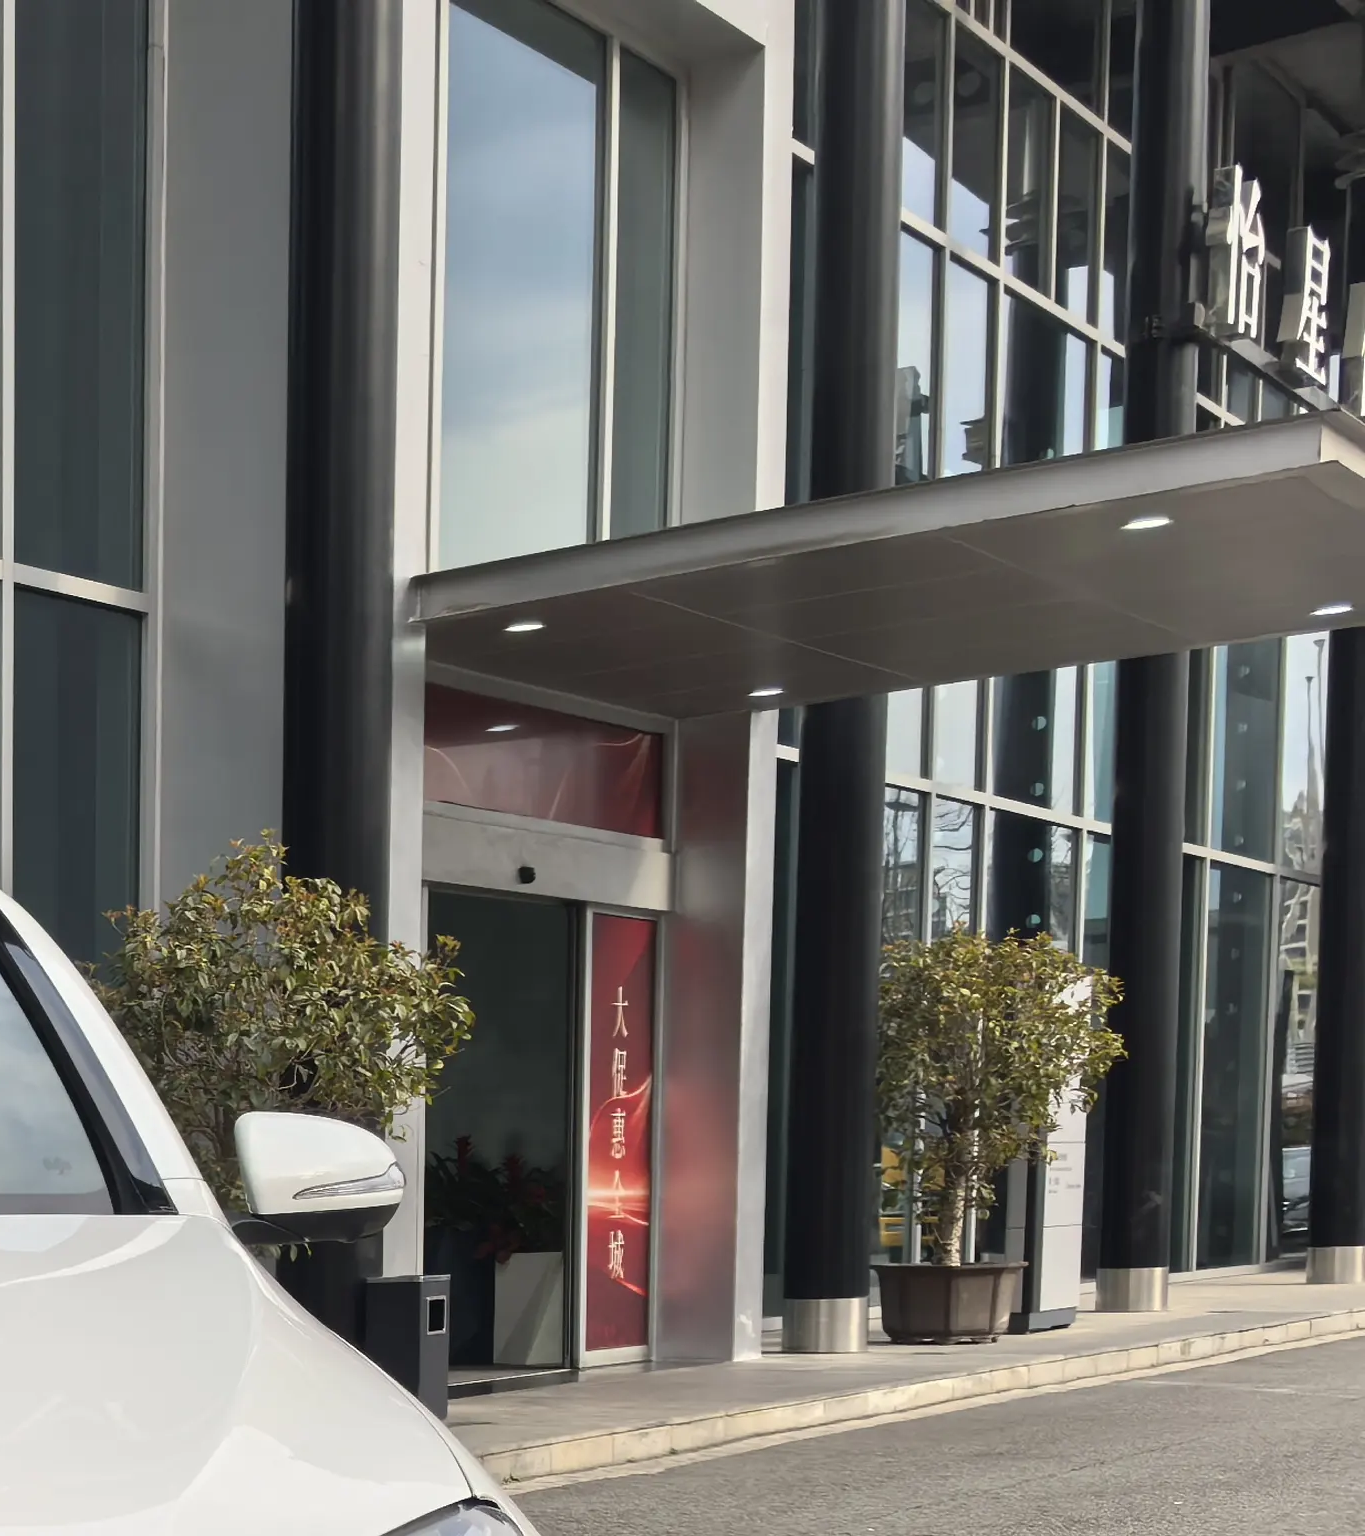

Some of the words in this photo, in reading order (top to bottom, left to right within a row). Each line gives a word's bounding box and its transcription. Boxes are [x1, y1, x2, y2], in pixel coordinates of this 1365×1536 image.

[1225, 163, 1365, 417] 怡星
[608, 985, 630, 1281] 大促惠全城
